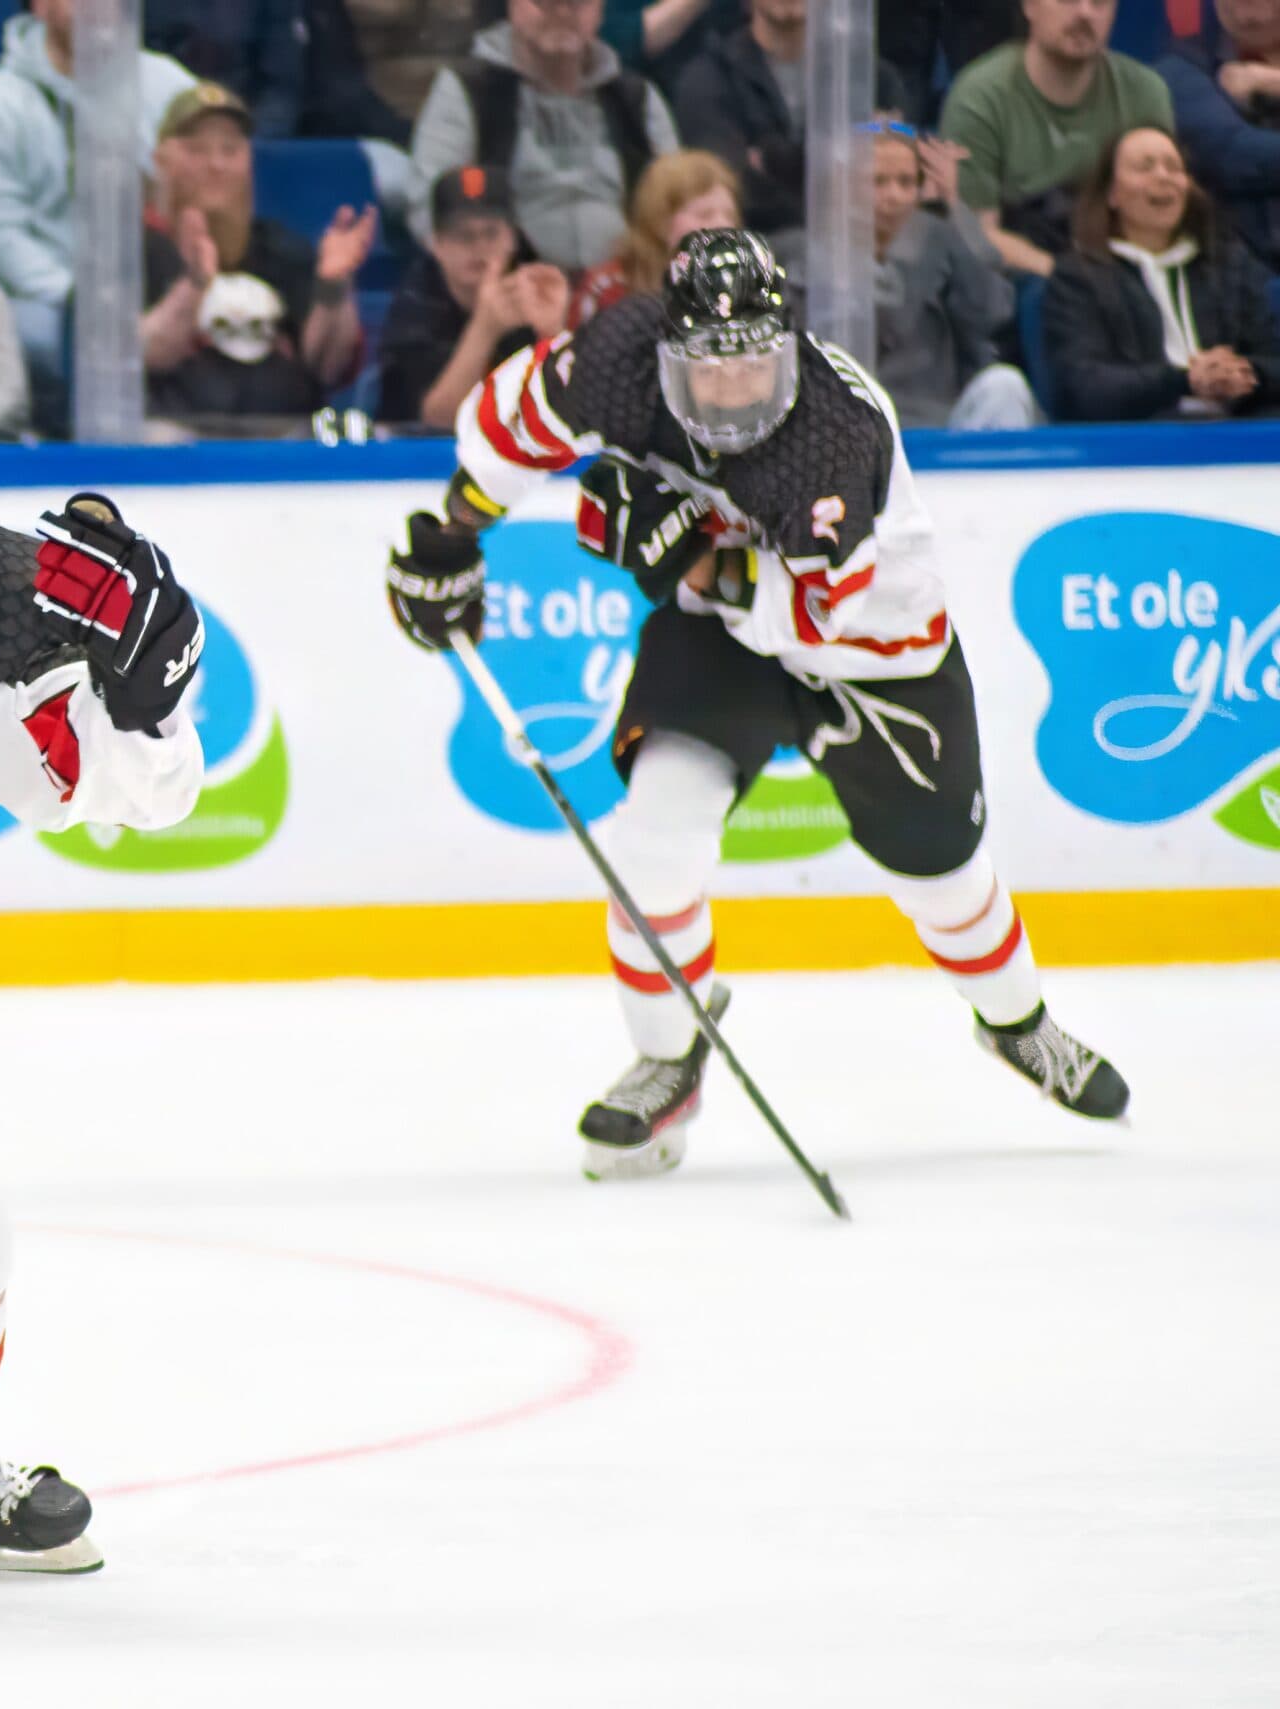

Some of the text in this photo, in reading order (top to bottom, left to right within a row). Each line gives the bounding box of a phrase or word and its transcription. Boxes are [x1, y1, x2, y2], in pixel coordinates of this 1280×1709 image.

[540, 577, 631, 639] ole
[1061, 568, 1219, 631] Et ole
